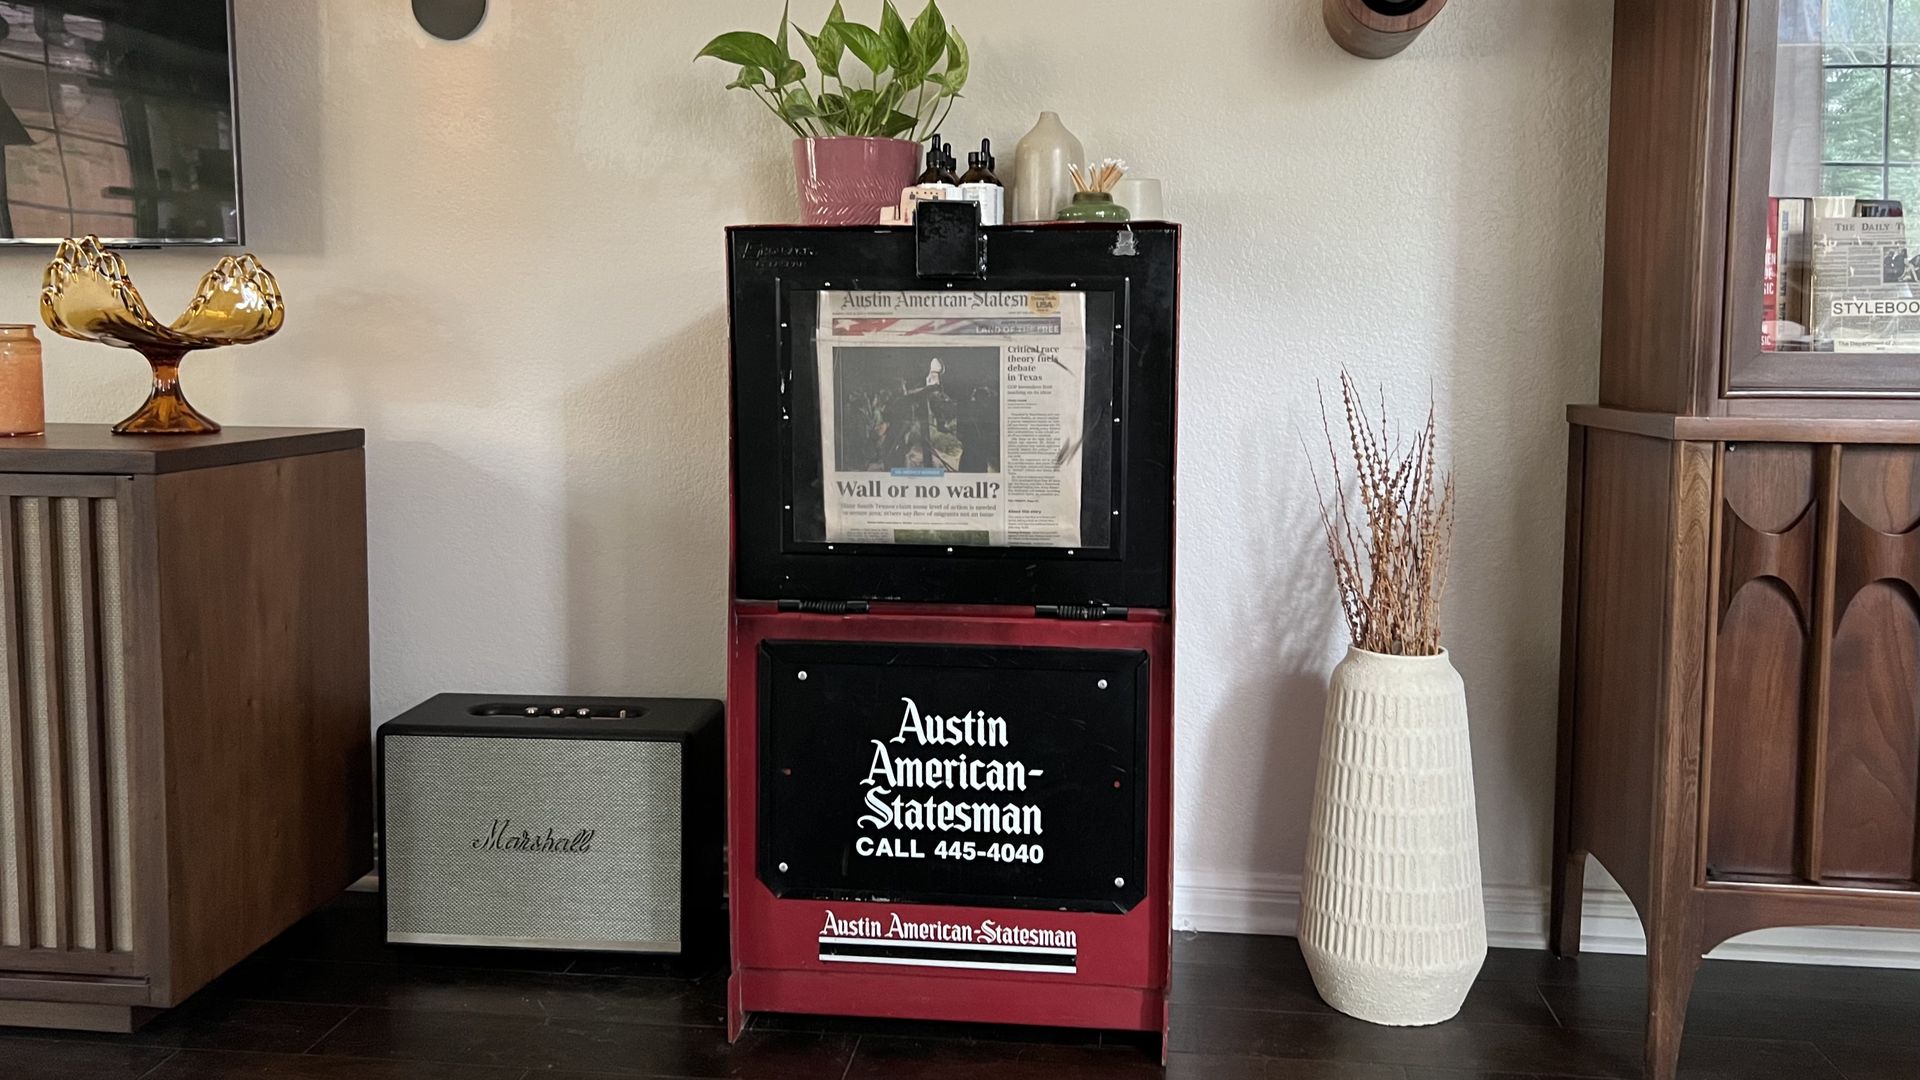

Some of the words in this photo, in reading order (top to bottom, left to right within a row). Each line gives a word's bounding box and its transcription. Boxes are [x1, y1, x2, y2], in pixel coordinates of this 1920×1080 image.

[1834, 222, 1856, 232] THE
[1861, 222, 1890, 232] DAILY
[841, 291, 892, 310] Austin
[1832, 301, 1920, 315] STYLEBOO
[1007, 345, 1039, 354] Critical
[1041, 346, 1059, 354] race
[1007, 355, 1035, 364] theory
[1007, 364, 1036, 372] debate
[837, 480, 882, 498] Wall
[887, 484, 909, 498] or
[914, 485, 941, 499] no
[945, 481, 1001, 499] wall?
[889, 697, 1008, 747] Austin
[859, 739, 1044, 792] American-
[856, 785, 1043, 835] Statesman
[472, 819, 595, 853] Marshall
[855, 837, 925, 859] CALL
[934, 840, 1044, 864] 445-4040
[819, 909, 882, 938] Austin
[884, 911, 1078, 948] American-Statesman
